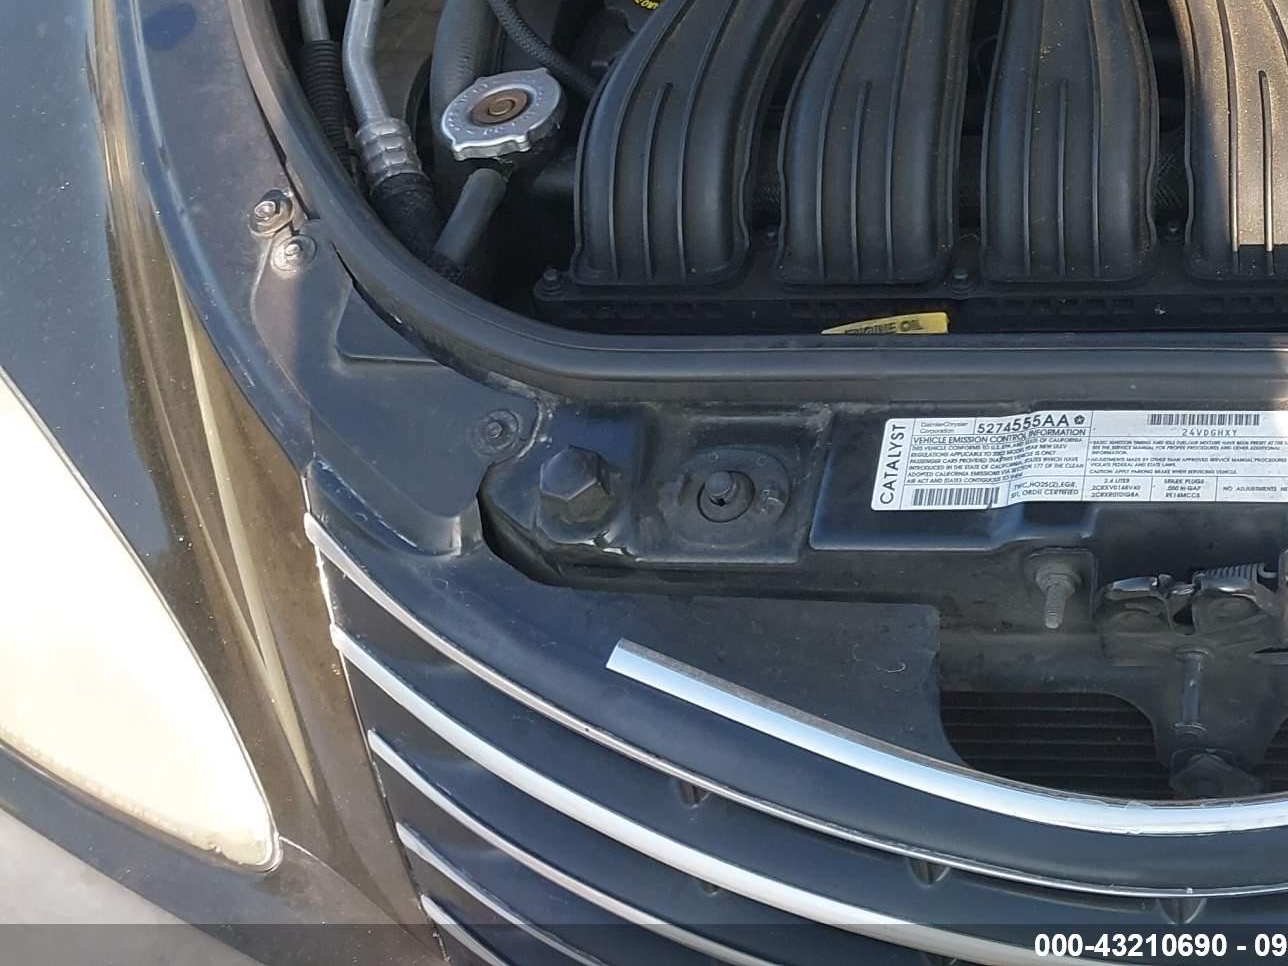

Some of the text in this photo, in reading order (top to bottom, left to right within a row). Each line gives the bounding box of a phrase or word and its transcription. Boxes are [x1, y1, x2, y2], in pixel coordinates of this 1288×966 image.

[900, 319, 924, 332] OIL
[921, 420, 969, 428] DaimlerChrysler
[977, 413, 1069, 434] 5274555AA
[913, 429, 1086, 444] VEHICLE EMISSION CONTROL INFORMATION
[880, 423, 907, 505] CATALYST
